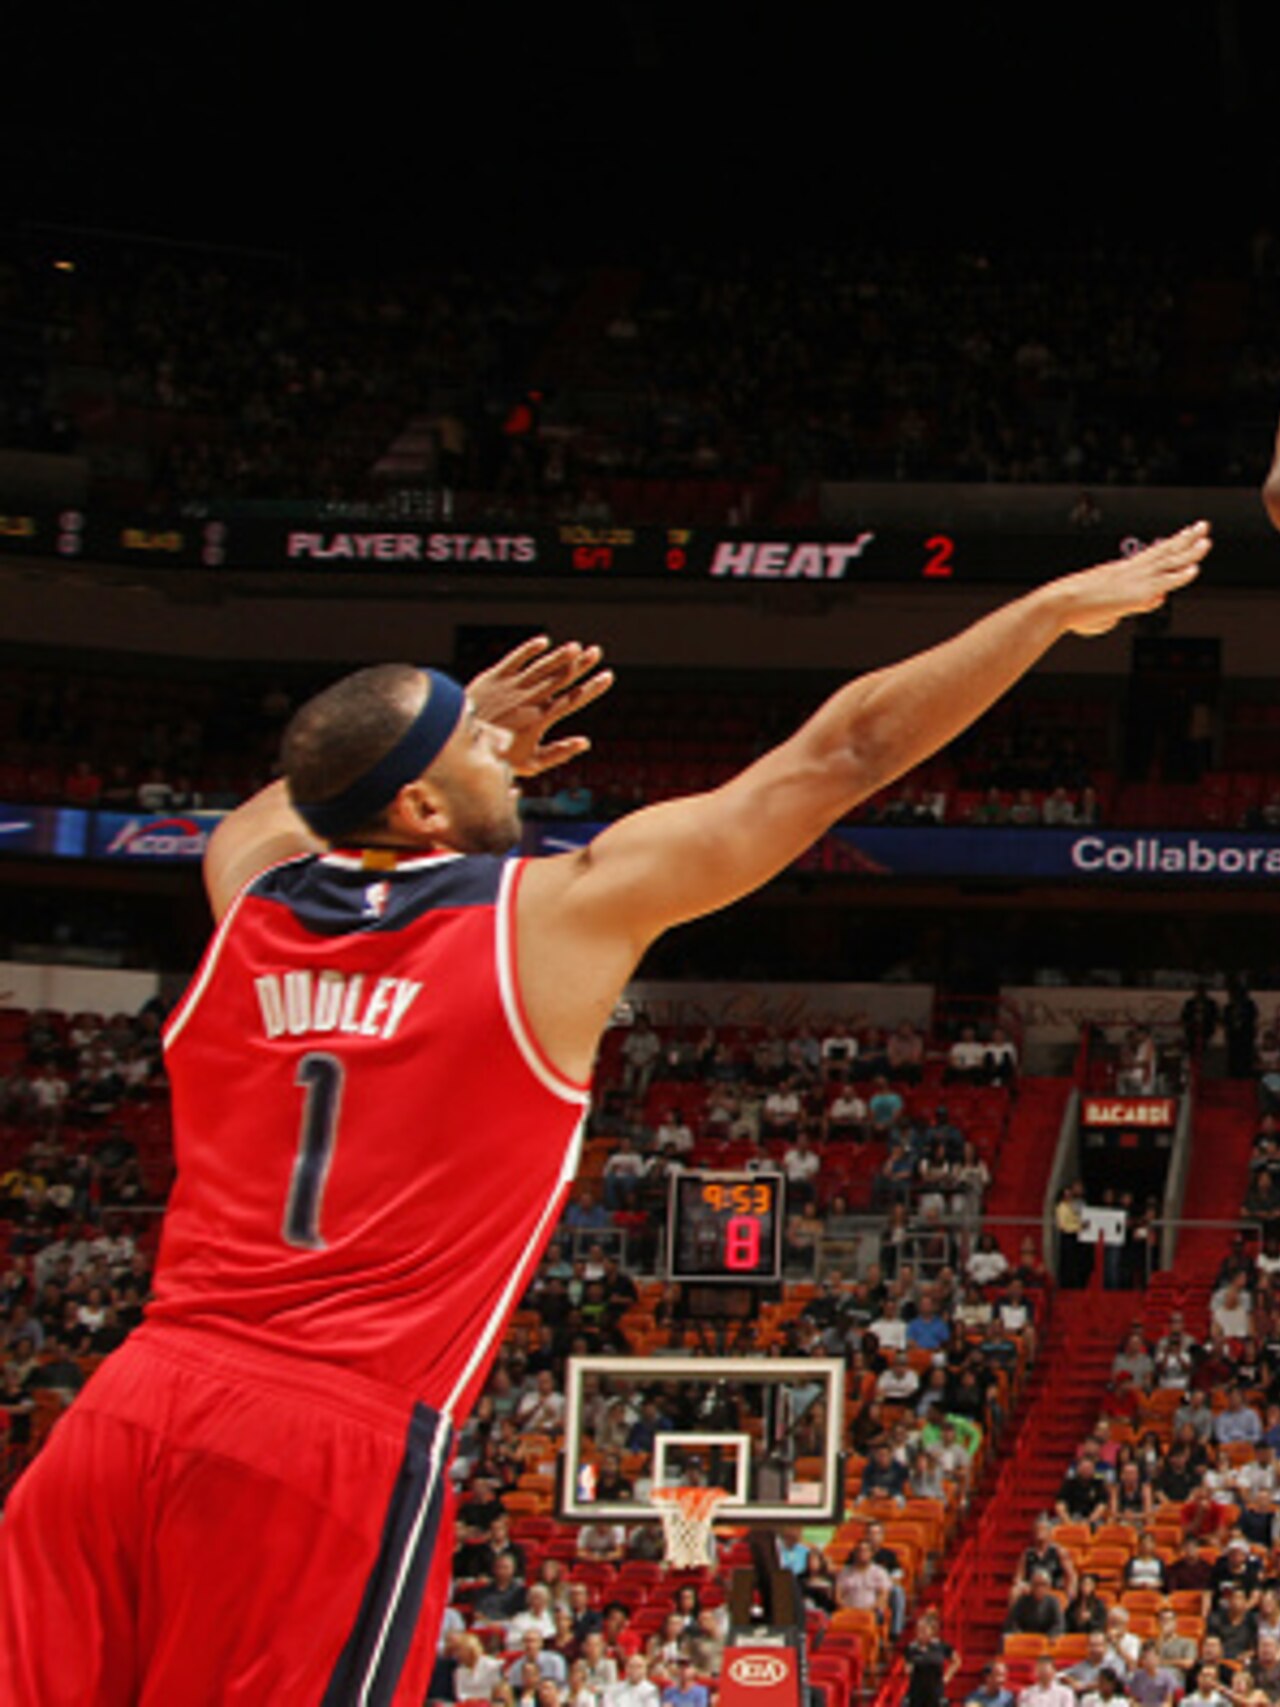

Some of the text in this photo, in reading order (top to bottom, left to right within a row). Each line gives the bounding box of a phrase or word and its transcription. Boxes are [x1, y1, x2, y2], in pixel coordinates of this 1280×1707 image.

[287, 532, 420, 560] PLAYER
[426, 535, 536, 563] STATS
[710, 531, 874, 578] HEAT
[922, 536, 955, 577] 2
[254, 969, 424, 1040] DUDLEY
[281, 1050, 345, 1251] 1
[701, 1183, 773, 1215] 9:53
[723, 1215, 761, 1271] 8
[734, 1657, 785, 1684] KIA
